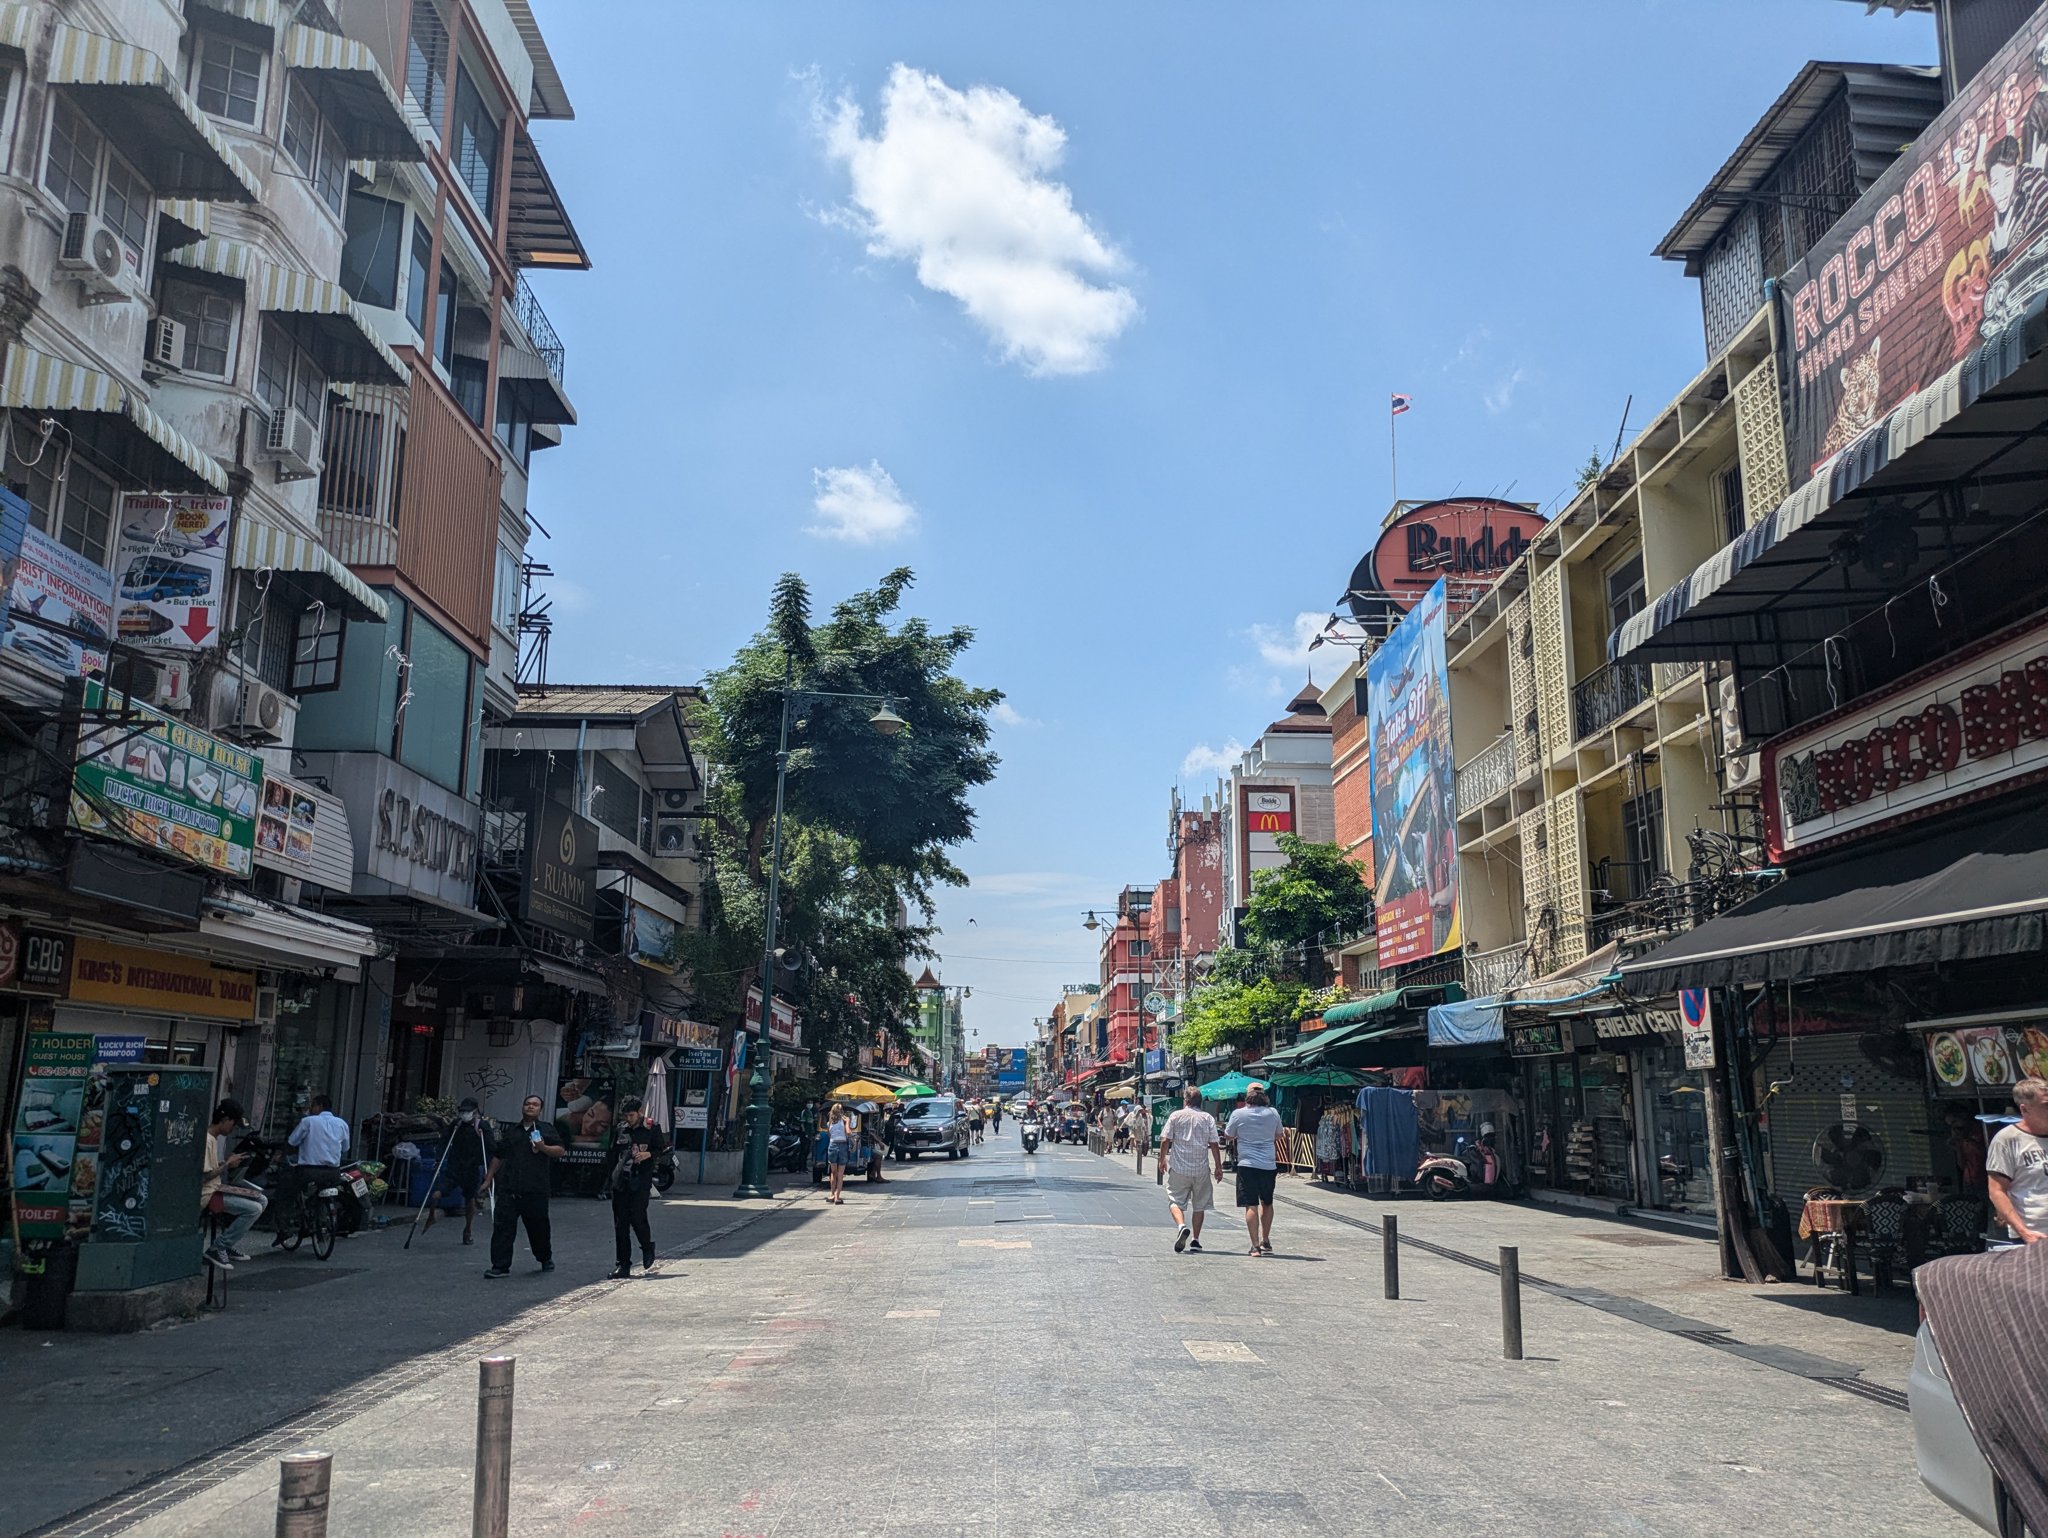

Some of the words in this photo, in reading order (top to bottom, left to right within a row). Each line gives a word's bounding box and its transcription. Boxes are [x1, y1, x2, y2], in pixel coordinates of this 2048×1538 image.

[1938, 72, 2024, 186] 1976
[1793, 161, 1938, 351] ROCCO
[128, 499, 184, 510] Thailand
[191, 499, 227, 511] travel
[1407, 524, 1530, 572] Budd
[1385, 711, 1407, 748] Take
[1408, 673, 1429, 722] Off
[172, 727, 212, 757] GUEST
[213, 744, 252, 774] HOUSE
[1414, 719, 1430, 747] Care
[1816, 703, 1961, 812] ROCCO
[106, 780, 143, 807] LUCKY
[144, 795, 170, 816] RICH
[544, 862, 585, 905] RUAMM
[27, 936, 64, 974] CBG
[78, 960, 124, 985] KING'S
[127, 966, 216, 998] INTERNATIONAL
[219, 979, 253, 1003] TAILOR
[31, 1038, 38, 1048] 7
[42, 1038, 92, 1049] HOLDER
[1595, 1014, 1648, 1038] JEWELRY
[59, 1053, 86, 1061] HOUSE
[572, 1150, 607, 1158] MASSAGE
[19, 1209, 59, 1220] TOILET
